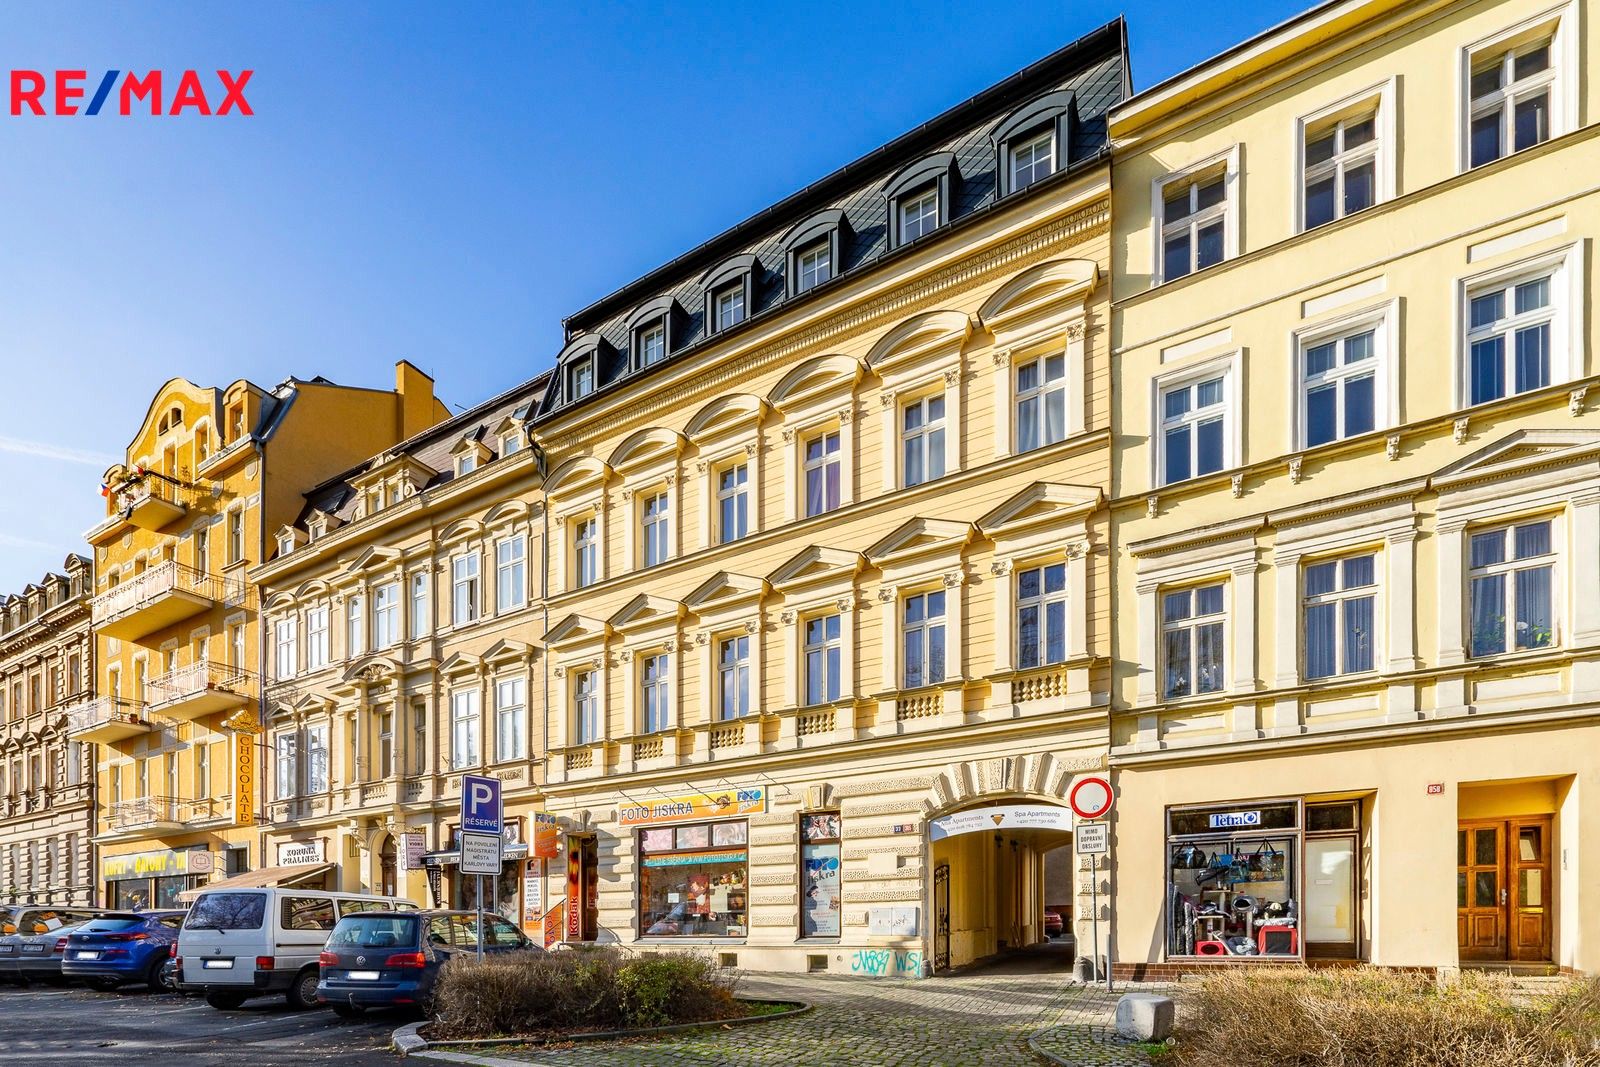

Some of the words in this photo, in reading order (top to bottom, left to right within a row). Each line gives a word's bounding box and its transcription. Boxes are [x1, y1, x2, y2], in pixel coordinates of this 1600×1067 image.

[239, 736, 250, 822] CHOCOLATE
[471, 783, 493, 814] P
[621, 807, 649, 821] FOTO
[653, 802, 693, 818] JISKRA
[952, 815, 984, 825] Apartments
[1211, 814, 1243, 827] Tetra
[283, 855, 320, 865] PRALINES
[806, 857, 839, 872] FOTO
[569, 895, 578, 936] Kodak
